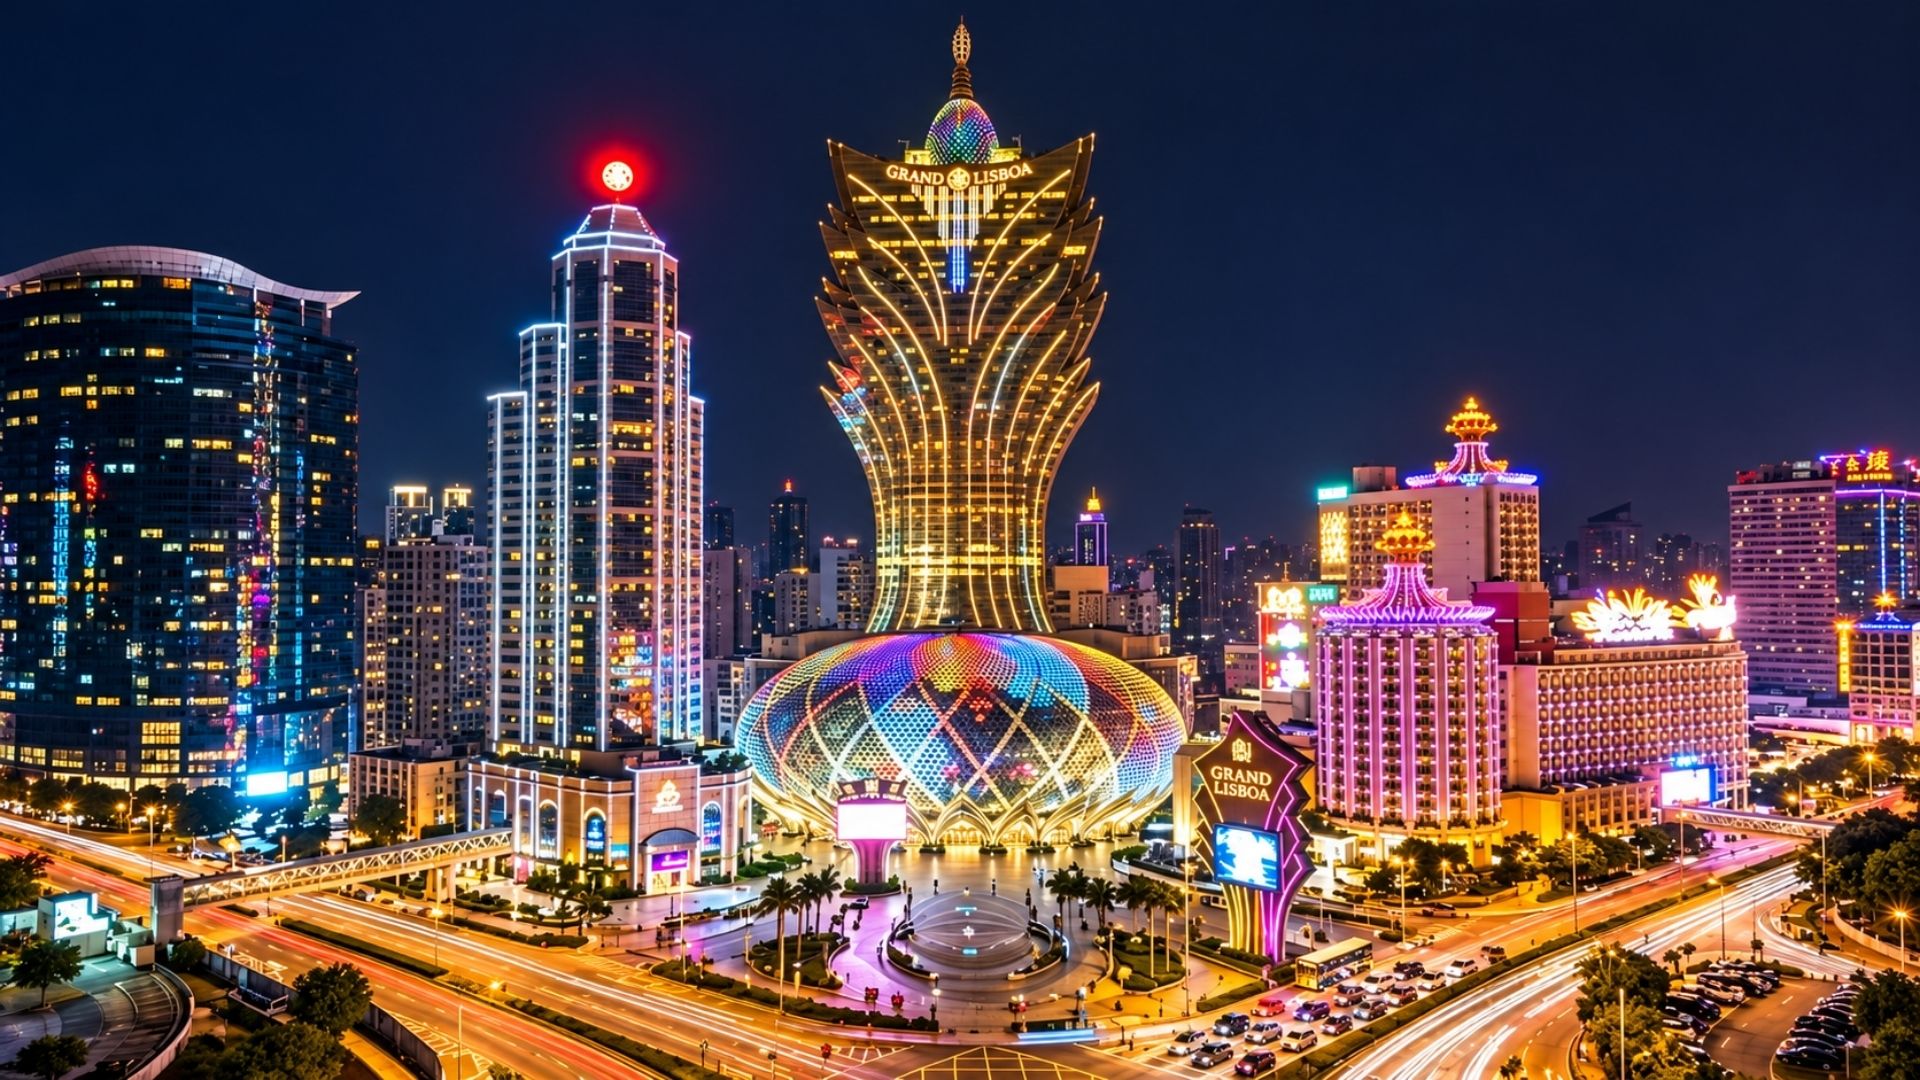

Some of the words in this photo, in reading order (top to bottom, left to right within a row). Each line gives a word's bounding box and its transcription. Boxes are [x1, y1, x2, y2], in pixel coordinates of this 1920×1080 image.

[886, 164, 945, 186] GRAND
[973, 162, 1033, 185] LISBOA
[1210, 765, 1272, 786] GRAND
[1214, 780, 1271, 802] LISBOA
